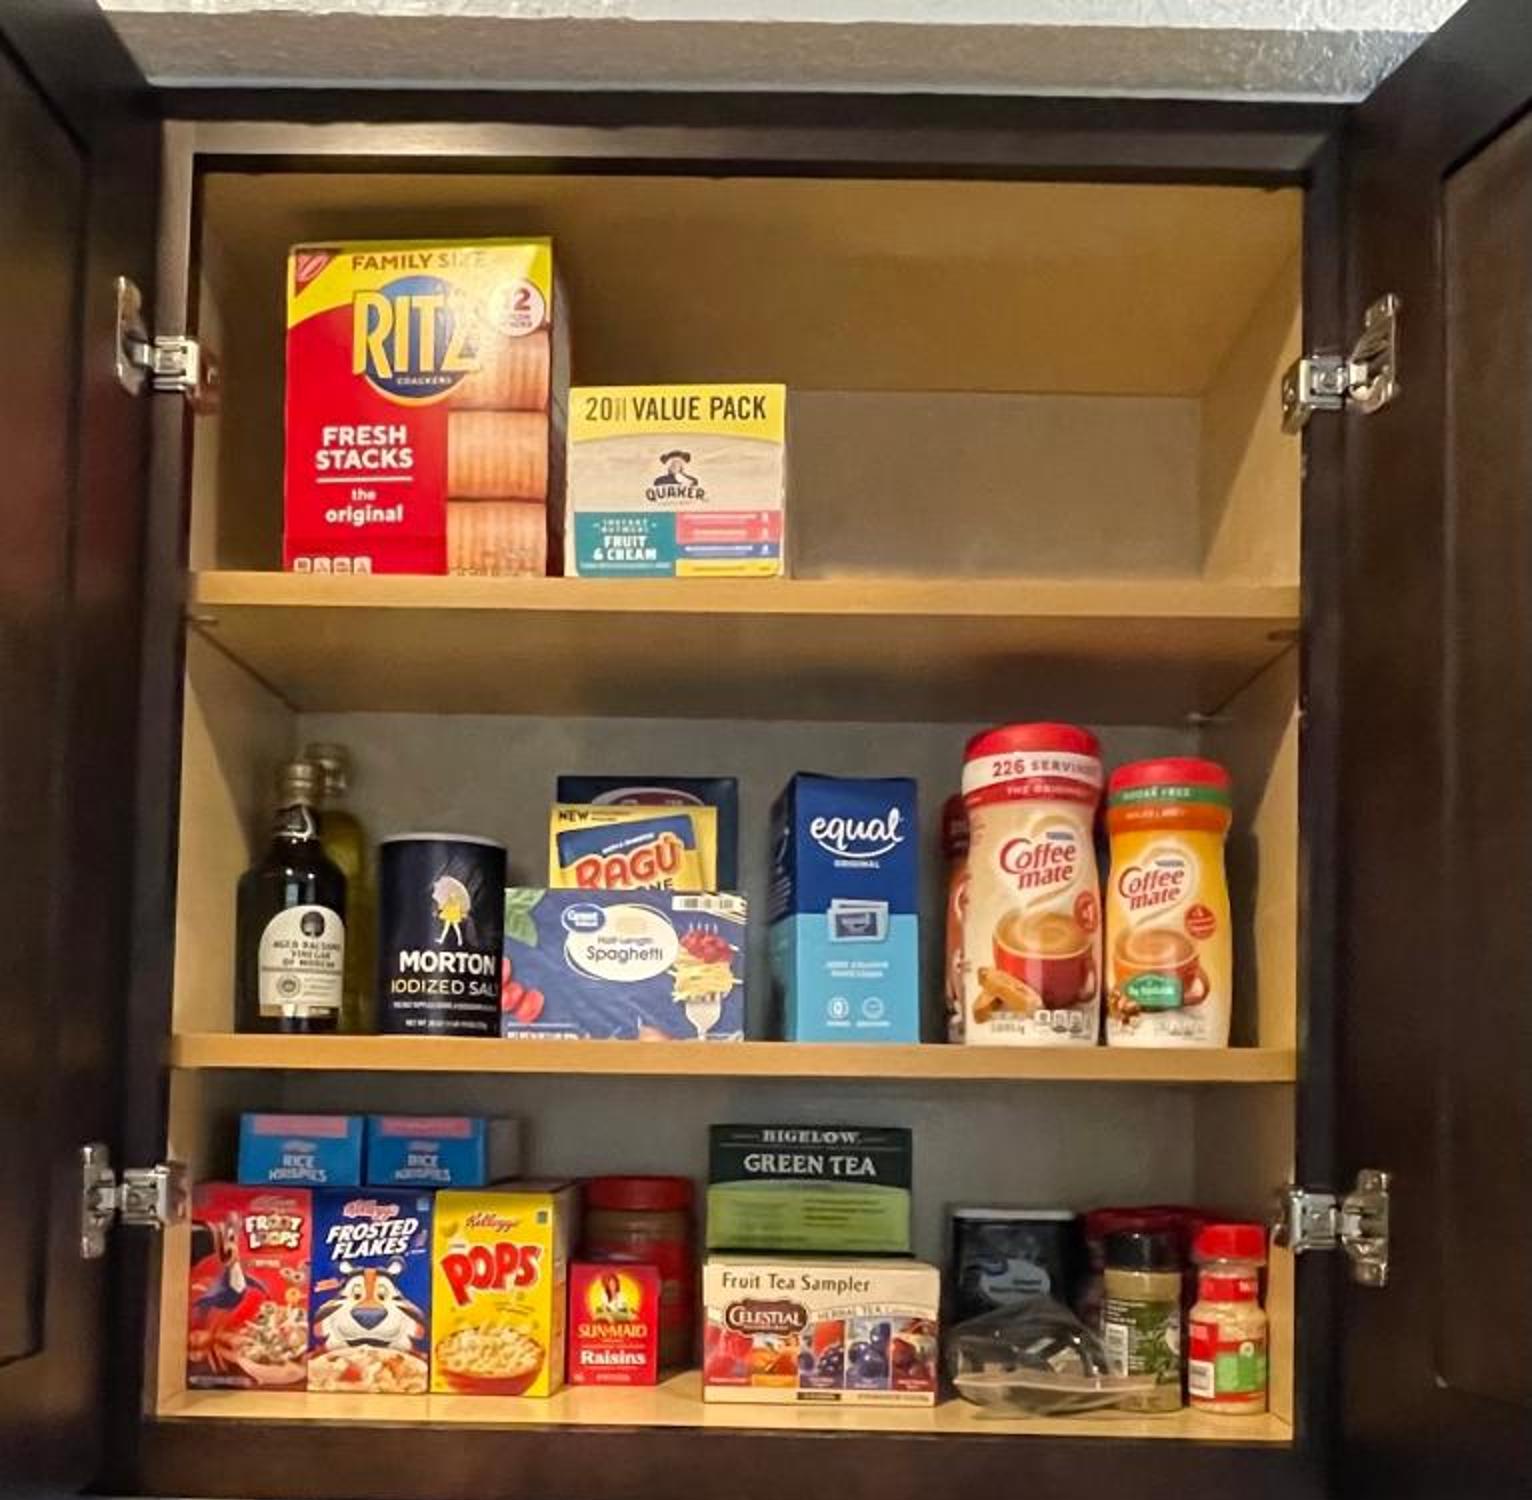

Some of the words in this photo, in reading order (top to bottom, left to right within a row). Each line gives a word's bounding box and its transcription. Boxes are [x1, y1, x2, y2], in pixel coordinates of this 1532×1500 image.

[352, 253, 433, 270] FAMILY
[353, 289, 481, 379] RITZ
[585, 397, 612, 421] 20
[633, 396, 700, 421] VALUE
[709, 395, 767, 420] PACK
[322, 427, 408, 446] FRESH
[315, 448, 414, 470] STACKS
[351, 489, 377, 501] the
[645, 486, 706, 502] QUAKER
[324, 505, 404, 527] original
[604, 536, 647, 548] FRUIT
[607, 548, 657, 561] CREAM
[992, 760, 1025, 778] 226
[559, 810, 589, 822] NEW
[809, 807, 905, 851] equal
[1000, 838, 1076, 875] Coffee
[1018, 864, 1073, 890] mate
[1118, 867, 1184, 898] Coffee
[1130, 888, 1181, 910] mate
[399, 950, 496, 976] MORTON
[586, 945, 664, 964] Spaghetti
[391, 978, 465, 995] IODIZED
[761, 1129, 860, 1144] BIGELOW
[283, 1155, 315, 1168] RICE
[743, 1153, 824, 1174] GREEN
[829, 1156, 877, 1177] TEA
[325, 1217, 419, 1244] FROSTED
[331, 1235, 410, 1261] FLAKES
[440, 1242, 543, 1306] POPS
[722, 1271, 760, 1288] Fruit
[768, 1273, 796, 1291] Tea
[801, 1275, 871, 1294] Sampler
[729, 1306, 801, 1325] CELESTIAL
[580, 1350, 647, 1365] Raisins
